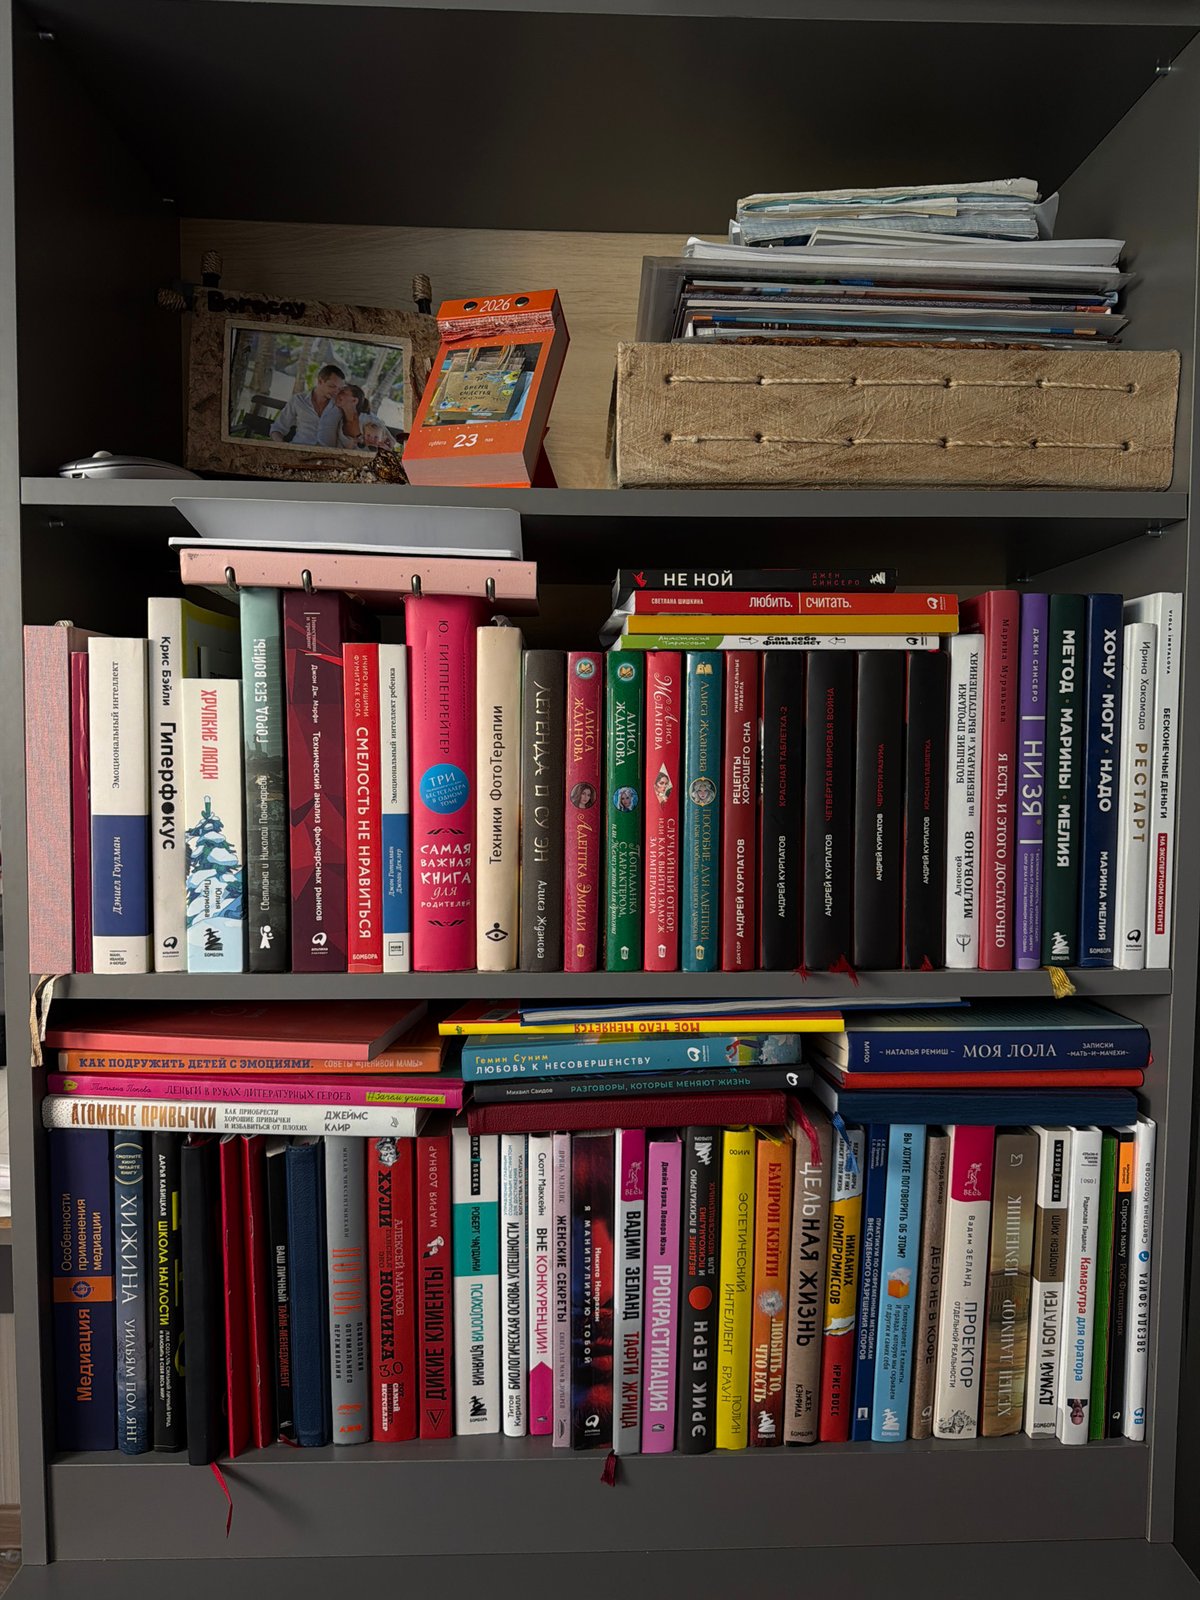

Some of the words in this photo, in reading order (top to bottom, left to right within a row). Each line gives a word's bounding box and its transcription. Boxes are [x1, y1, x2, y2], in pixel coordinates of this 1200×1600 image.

[207, 291, 305, 318] Boracay
[480, 298, 511, 312] 2026
[453, 434, 478, 448] 23
[664, 573, 687, 586] НЕ
[694, 570, 733, 586] НОЙ
[161, 636, 171, 666] Крис
[1032, 628, 1040, 655] ДЖЕН
[1060, 630, 1076, 693] МЕТОД
[1103, 628, 1116, 679] ХОЧУ
[1141, 642, 1150, 675] Ирина
[111, 661, 119, 709] интеллект
[162, 670, 172, 706] Бэйли
[310, 665, 319, 684] Джон
[352, 654, 361, 695] ФУМИТАКЕ
[361, 655, 369, 681] ИЧИРО
[388, 668, 396, 699] ребенка
[1031, 659, 1040, 702] СИНСЕРО
[311, 686, 319, 698] Дж.
[311, 700, 320, 723] Мэрфи
[354, 697, 362, 717] КОГА
[361, 683, 370, 717] КИШИМИ
[957, 683, 966, 732] ПРОДАЖИ
[1137, 679, 1149, 730] Хакамада
[389, 701, 397, 739] интеллект
[626, 711, 636, 755] АЛИСА
[743, 721, 751, 743] СНА
[780, 705, 788, 761] ТАБЛЕТКА-2
[1101, 693, 1114, 744] МОГУ
[111, 712, 120, 788] Эмоциональный
[312, 731, 322, 789] Технический
[956, 735, 965, 784] БОЛЬШИЕ
[998, 752, 1007, 762] Я
[1058, 708, 1073, 789] МАРИНЫ
[1161, 708, 1170, 778] БЕСКОНЕЧНЫЕ
[356, 727, 370, 815] СМЕЛОСТЬ
[389, 742, 397, 804] Эмоциональный
[733, 756, 742, 804] РЕЦЕПТЫ
[742, 746, 751, 804] ХОРОШЕГО
[779, 764, 787, 807] КРАСНАЯ
[996, 765, 1007, 801] ЕСТЬ,
[1098, 759, 1112, 811] НАДО
[313, 792, 322, 823] анализ
[997, 803, 1007, 814] И
[1133, 743, 1148, 843] РЕСТАРТ
[1160, 781, 1169, 819] ДЕНЬГИ
[358, 820, 370, 840] НЕ
[420, 844, 472, 854] САМАЯ
[649, 836, 658, 849] ЗА
[875, 813, 884, 850] КУРПАТОВ
[922, 817, 931, 853] КУРПАТОВ
[996, 817, 1007, 858] ЭТОГО
[1056, 804, 1070, 867] МЕЛИЯ
[1159, 835, 1167, 845] НА
[111, 837, 122, 877] Гоулман
[313, 826, 324, 884] фьючерсных
[421, 858, 472, 866] ВАЖНАЯ
[736, 839, 745, 893] КУРПАТОВ
[778, 835, 786, 881] КУРПАТОВ
[825, 834, 833, 879] КУРПАТОВ
[875, 852, 883, 881] АНДРЕЙ
[922, 855, 930, 884] АНДРЕЙ
[964, 831, 974, 918] МИЛОВАНОВ
[1098, 851, 1109, 898] МАРИНА
[1157, 847, 1165, 894] ЭКСПЕРТНОМ
[358, 845, 372, 938] НРАВИТЬСЯ
[420, 872, 472, 884] КНИГА
[649, 851, 657, 914] ИМПЕРАТОРА
[954, 856, 962, 896] Алексей
[112, 880, 123, 914] Дэниел
[203, 879, 212, 918] Пирумова
[215, 887, 223, 909] Юлия
[313, 887, 324, 921] рынков
[421, 900, 471, 908] РОДИТЕЛЕЙ
[735, 896, 745, 938] АНДРЕЙ
[777, 882, 786, 917] АНДРЕЙ
[824, 881, 833, 916] АНДРЕЙ
[994, 861, 1006, 948] ДОСТАТОЧНО
[1156, 895, 1164, 932] КОНТЕНТЕ
[1098, 902, 1109, 940] МЕЛИЯ
[735, 941, 743, 964] ДОКТОР
[574, 1023, 634, 1034] МЕНЯЕТСЯ
[638, 1023, 670, 1034] ТЕЛО
[674, 1022, 700, 1033] МОЕ
[1082, 1041, 1114, 1050] ЗАПИСКИ
[476, 1063, 527, 1075] ЛЮБОВЬ
[531, 1062, 540, 1070] К
[544, 1057, 652, 1070] НЕСОВЕРШЕНСТВУ
[885, 1048, 919, 1056] НАТАЛЬЯ
[921, 1047, 949, 1056] РЕМИШ
[962, 1044, 1002, 1058] МОЯ
[1007, 1044, 1056, 1058] ЛОЛА
[325, 1110, 368, 1122] ДЖЕЙМС
[903, 1133, 912, 1144] ВЫ
[427, 1146, 439, 1187] ДОВНАР
[902, 1146, 911, 1174] ХОТИТЕ
[689, 1169, 698, 1226] ПСИХИАТРИЮ
[768, 1162, 782, 1224] БАЙРОН
[899, 1175, 910, 1221] ПОГОВОРИТЬ
[1143, 1162, 1152, 1202] Колосова
[428, 1192, 438, 1228] МАРИЯ
[898, 1223, 907, 1234] ОБ
[967, 1215, 975, 1245] Вадим
[1119, 1199, 1130, 1232] Спроси
[1142, 1205, 1151, 1244] Светлана
[61, 1193, 73, 1271] Особенности
[75, 1199, 88, 1271] применения
[91, 1212, 103, 1270] медиации
[120, 1195, 139, 1304] ХИЖИНА
[158, 1221, 169, 1264] ШКОЛА
[506, 1222, 520, 1279] УСПЕШНОСТИ
[556, 1215, 567, 1268] ЖЕНСКИЕ
[625, 1211, 641, 1259] ВАДИМ
[698, 1206, 708, 1268] ПСИХОАНАЛИЗ
[765, 1227, 781, 1277] КЕЙТИ
[897, 1235, 907, 1258] ЭТОМ?
[1118, 1234, 1127, 1258] маму
[688, 1235, 697, 1276] ВВЕДЕНИЕ
[698, 1269, 707, 1277] И
[929, 1246, 941, 1284] ДЕЛО
[963, 1249, 973, 1287] ЗЕЛАНД
[159, 1266, 170, 1326] НАГЛОСТИ
[425, 1267, 444, 1342] КЛИЕНТЫ
[506, 1281, 520, 1315] ОСНОВА
[557, 1273, 567, 1322] СЕКРЕТЫ
[623, 1267, 640, 1320] ЗЕЛАНД
[928, 1287, 939, 1307] НЕ
[1078, 1257, 1091, 1314] Камасутра
[1138, 1272, 1148, 1307] ЭФИРА
[928, 1313, 938, 1322] В
[951, 1301, 961, 1341] ОТДЕЛЬНОЙ
[1041, 1290, 1058, 1344] БОГАТЕЙ
[1075, 1317, 1088, 1336] для
[1137, 1311, 1148, 1353] ЗВЕЗДА
[76, 1308, 93, 1401] Медиация
[507, 1318, 520, 1390] БИОЛОГИЧЕСКАЯ
[623, 1332, 639, 1375] ТАФТИ
[648, 1264, 672, 1412] ПРОКРАСТИНАЦИЯ
[693, 1320, 708, 1371] БЕРН
[925, 1326, 938, 1365] КОФЕ
[959, 1301, 977, 1389] ПРОЕКТОР
[1041, 1349, 1055, 1358] И
[426, 1348, 447, 1401] ДИКИЕ
[949, 1343, 959, 1388] РЕАЛЬНОСТИ
[1074, 1339, 1086, 1381] оратора
[1039, 1362, 1056, 1406] ДУМАЙ
[506, 1395, 515, 1418] Титов
[513, 1395, 522, 1426] Кирилл
[621, 1381, 638, 1429] ЖРИЦА
[691, 1381, 708, 1437] ЭРИК
